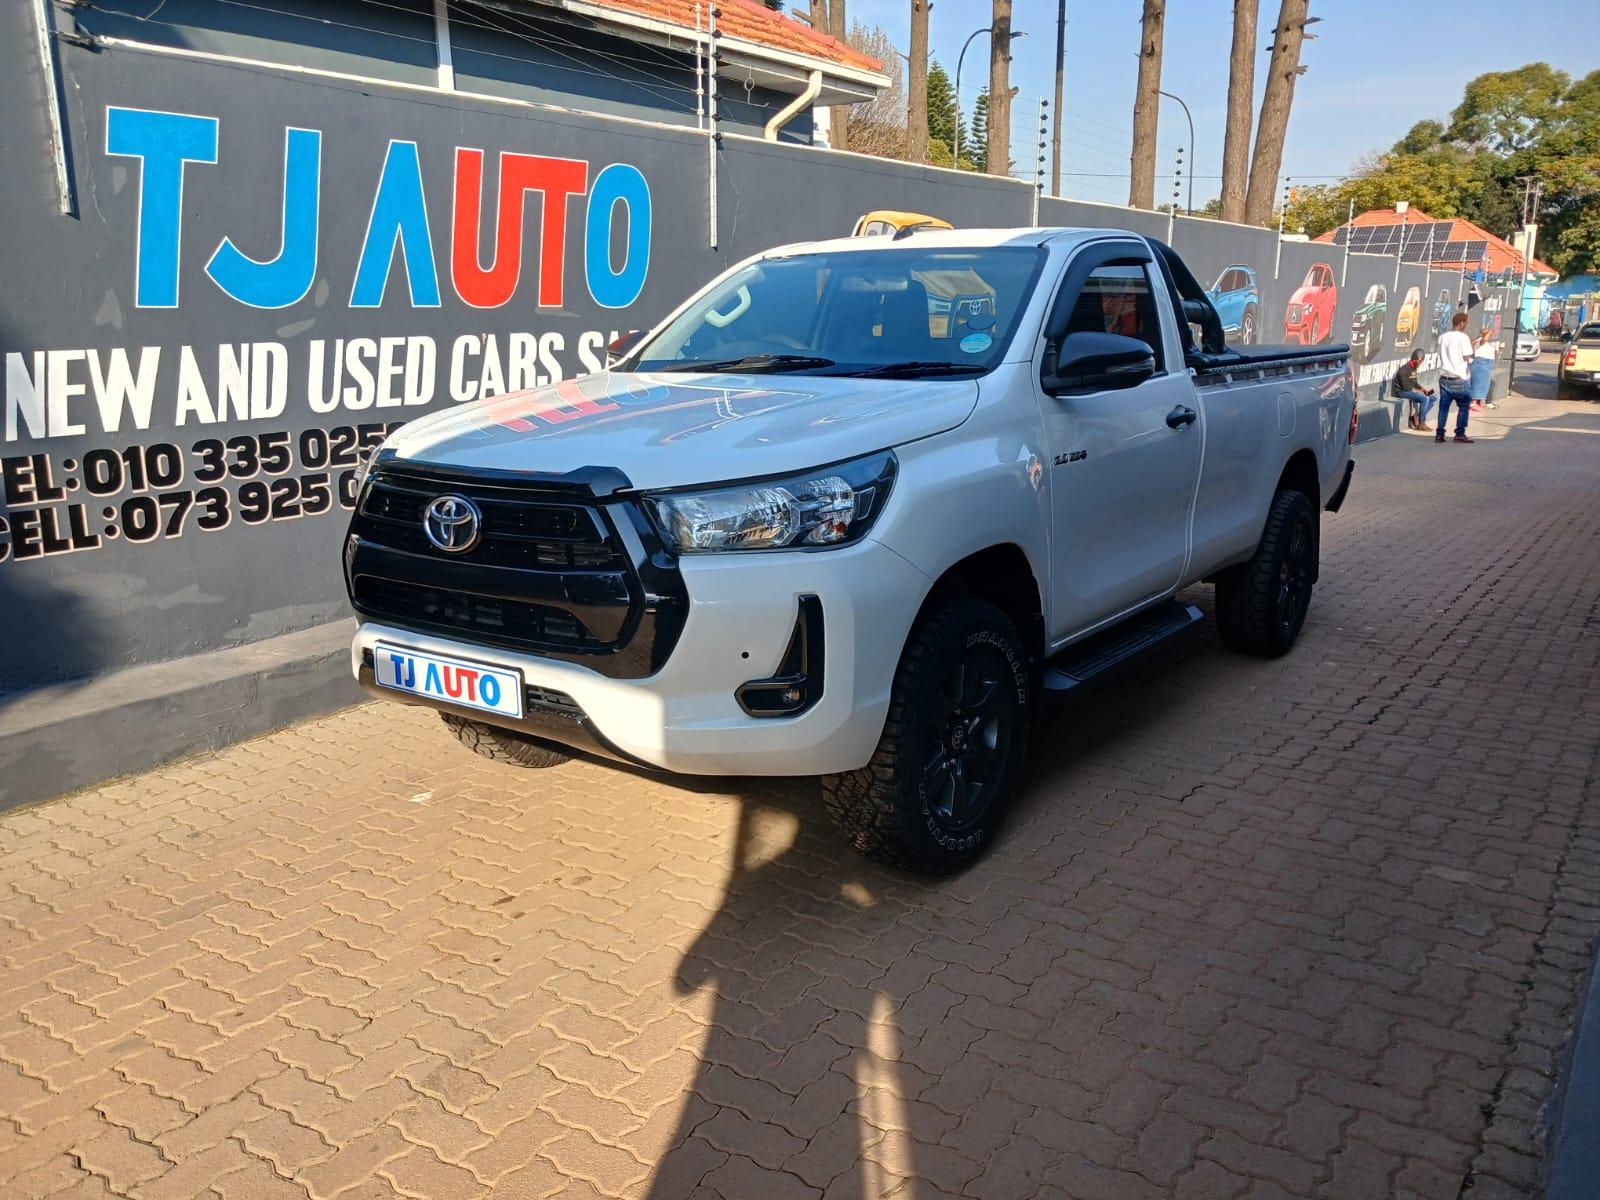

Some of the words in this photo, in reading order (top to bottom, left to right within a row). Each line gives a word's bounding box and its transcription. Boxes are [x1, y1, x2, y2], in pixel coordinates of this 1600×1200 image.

[105, 105, 322, 309] TJ
[348, 139, 652, 309] AUTO
[5, 346, 161, 441] NEW
[175, 342, 289, 426] AND
[308, 336, 437, 413] USED
[450, 332, 564, 402] CARS
[192, 431, 293, 483] 335
[299, 422, 407, 471] 025
[238, 473, 332, 526] 925
[390, 653, 415, 688] TJ
[425, 662, 501, 706] AUTO
